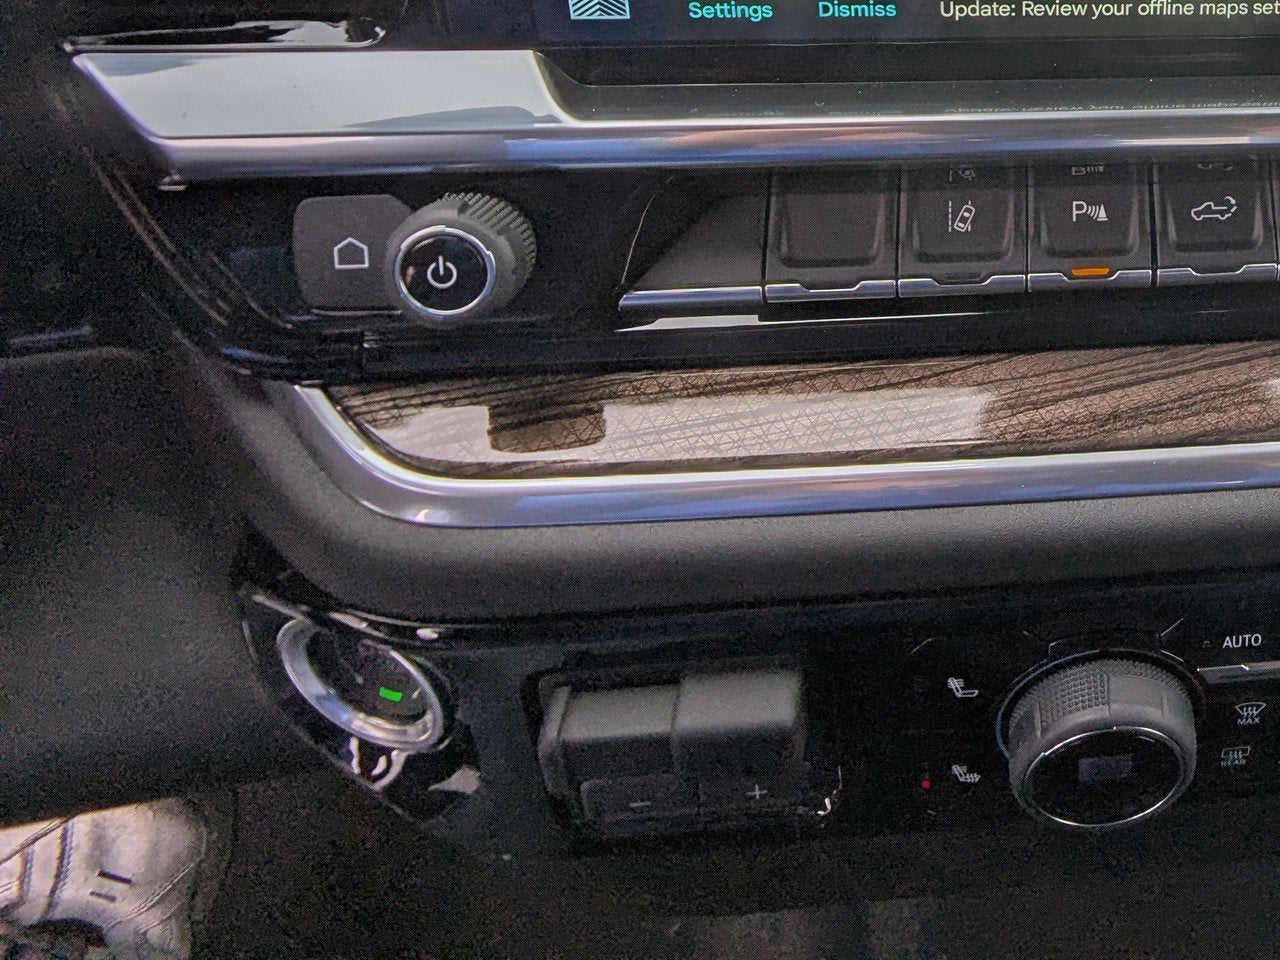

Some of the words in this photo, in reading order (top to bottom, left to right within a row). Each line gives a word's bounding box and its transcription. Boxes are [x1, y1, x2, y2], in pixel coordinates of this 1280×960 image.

[688, 0, 774, 23] Settings
[818, 0, 897, 18] Dismiss
[939, 0, 1017, 21] Update:
[1021, 0, 1088, 17] Review
[1091, 3, 1134, 21] your
[1199, 1, 1249, 19] maps
[1222, 634, 1262, 649] AUTO
[1237, 716, 1261, 726] MAX
